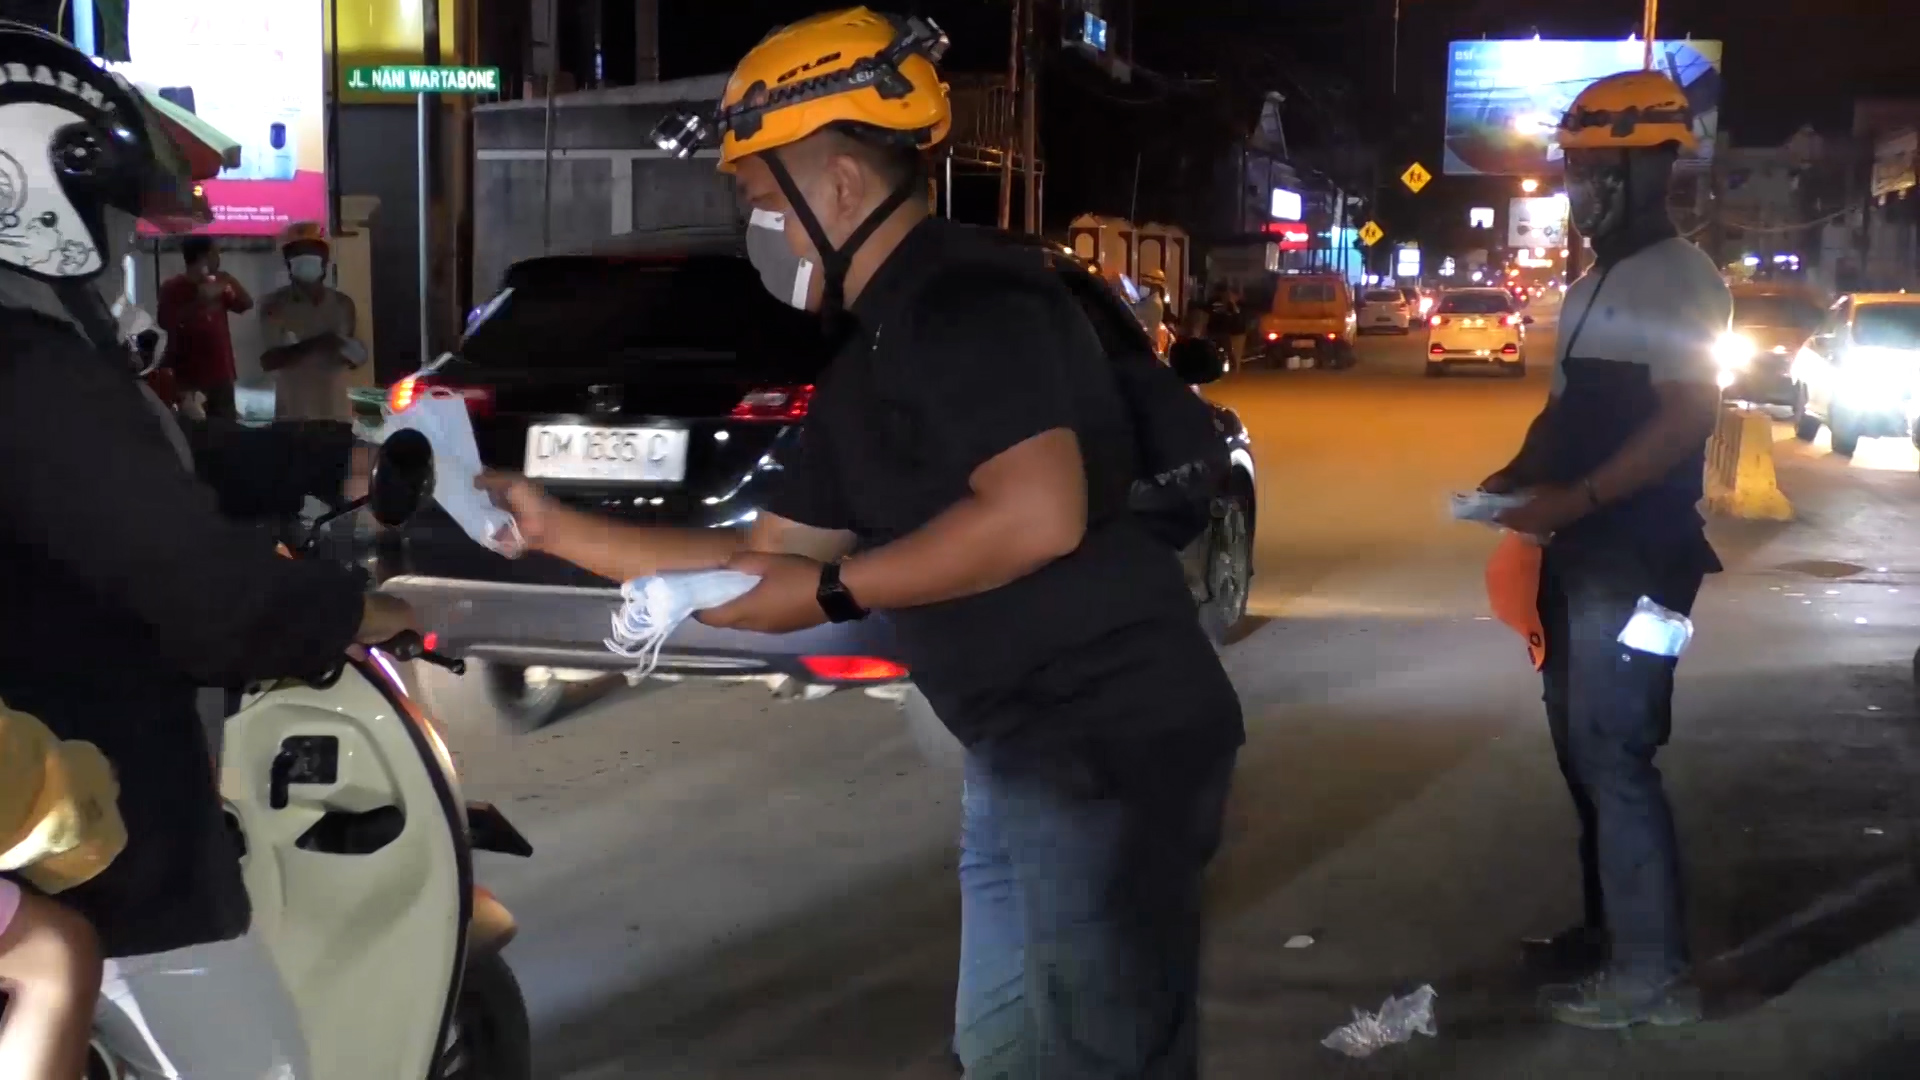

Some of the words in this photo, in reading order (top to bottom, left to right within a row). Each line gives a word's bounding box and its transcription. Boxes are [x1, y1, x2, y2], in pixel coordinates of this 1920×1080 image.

[372, 69, 406, 88] NANI
[408, 69, 496, 89] WARTABONE
[648, 432, 669, 466] C
